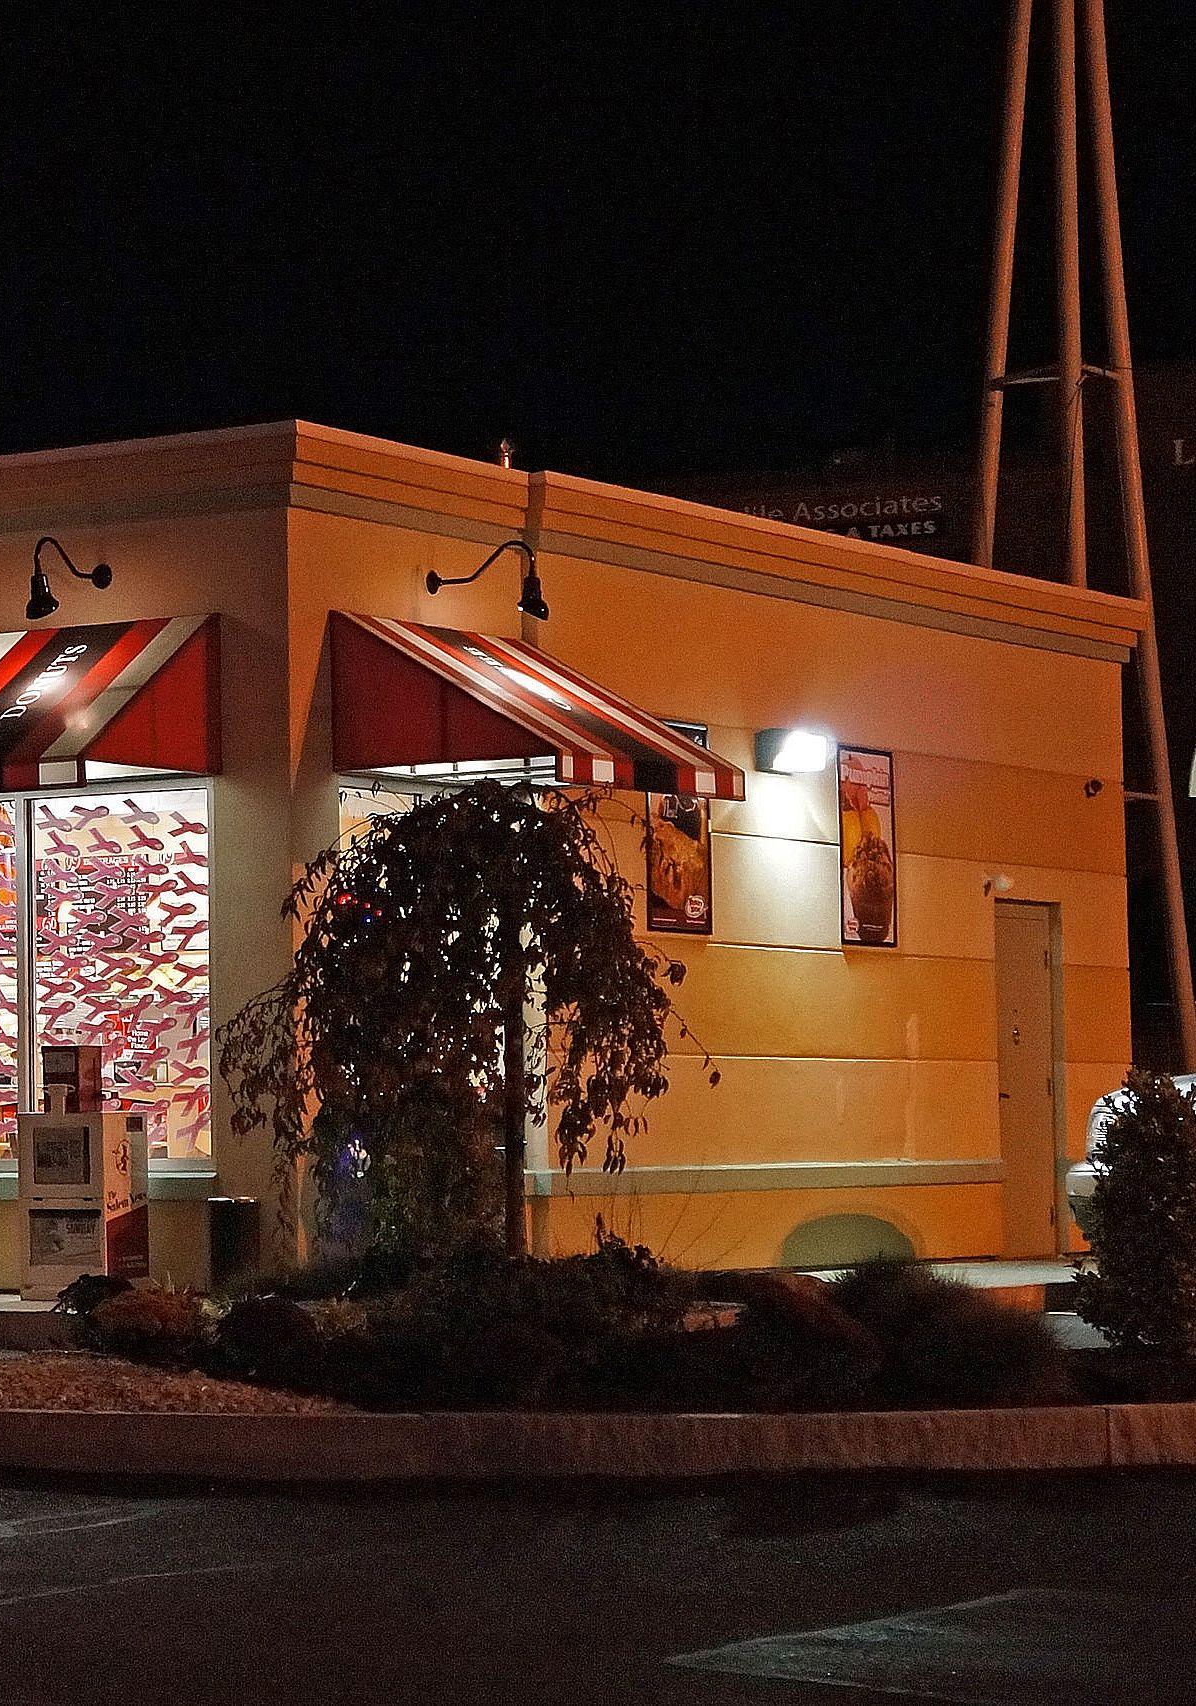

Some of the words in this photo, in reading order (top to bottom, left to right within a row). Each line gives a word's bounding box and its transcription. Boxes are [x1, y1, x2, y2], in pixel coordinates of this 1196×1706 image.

[791, 494, 943, 523] Associates
[867, 519, 937, 539] TAXES
[0, 644, 88, 721] DONUTS
